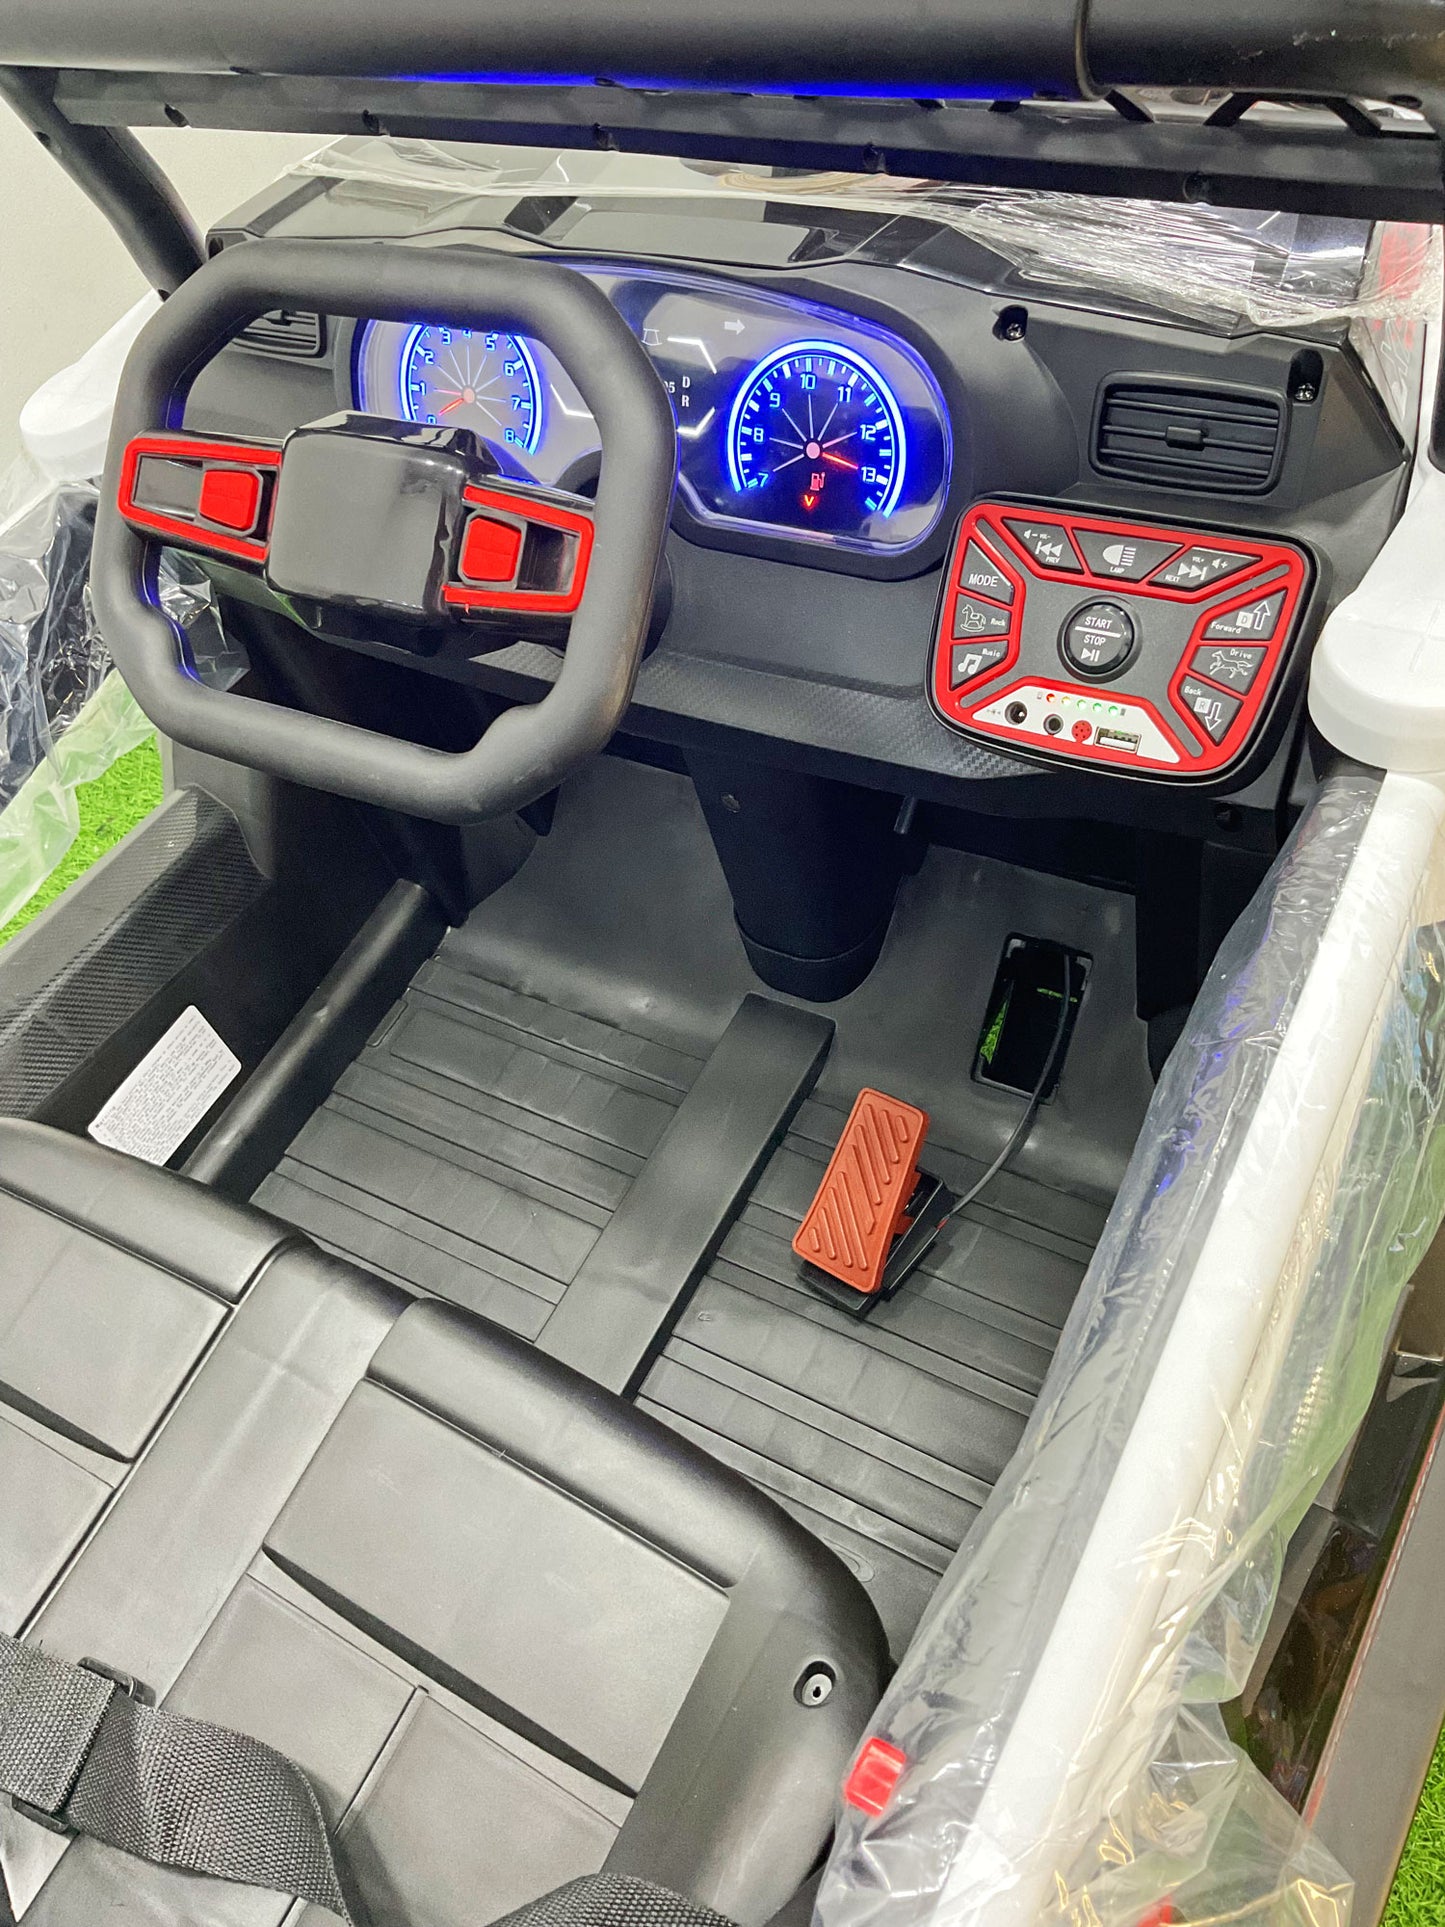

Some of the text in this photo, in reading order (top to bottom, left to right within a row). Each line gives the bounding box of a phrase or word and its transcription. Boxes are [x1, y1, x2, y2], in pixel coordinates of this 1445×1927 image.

[442, 331, 451, 345] 3
[486, 335, 496, 351] 5
[424, 351, 434, 365] 2
[504, 361, 514, 377] 6
[420, 382, 426, 396] 1
[682, 376, 691, 388] D
[800, 373, 815, 390] 10
[681, 394, 690, 407] R
[769, 392, 781, 408] 9
[837, 386, 852, 403] 11
[511, 395, 521, 411] 7
[505, 428, 515, 443] 8
[753, 427, 764, 443] 8
[860, 424, 877, 441] 12
[758, 472, 769, 488] 7
[861, 466, 877, 483] 13
[1109, 566, 1126, 574] LAMP
[968, 573, 999, 588] MODE
[1084, 616, 1113, 630] START
[1210, 620, 1242, 634] Forward
[1083, 634, 1106, 647] STOP
[1230, 648, 1253, 660] Drive
